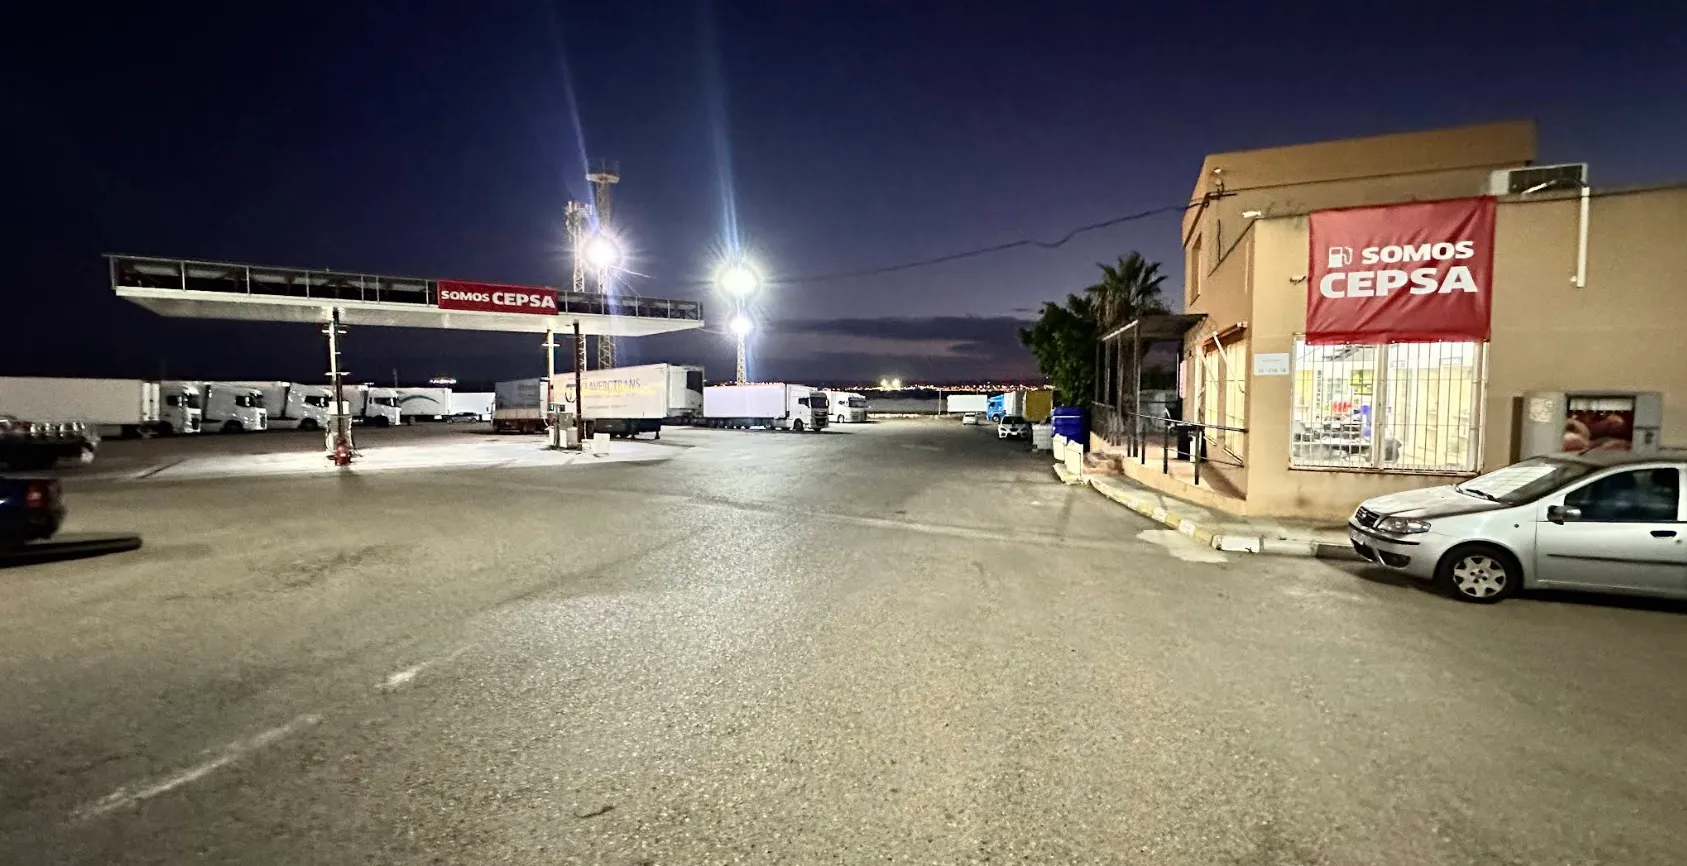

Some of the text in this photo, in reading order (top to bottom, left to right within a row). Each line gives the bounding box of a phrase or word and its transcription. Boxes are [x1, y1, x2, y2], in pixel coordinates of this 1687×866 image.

[1361, 240, 1474, 265] SOMOS
[1319, 265, 1479, 299] CEPSA
[441, 290, 556, 309] SOMOS CEPSA
